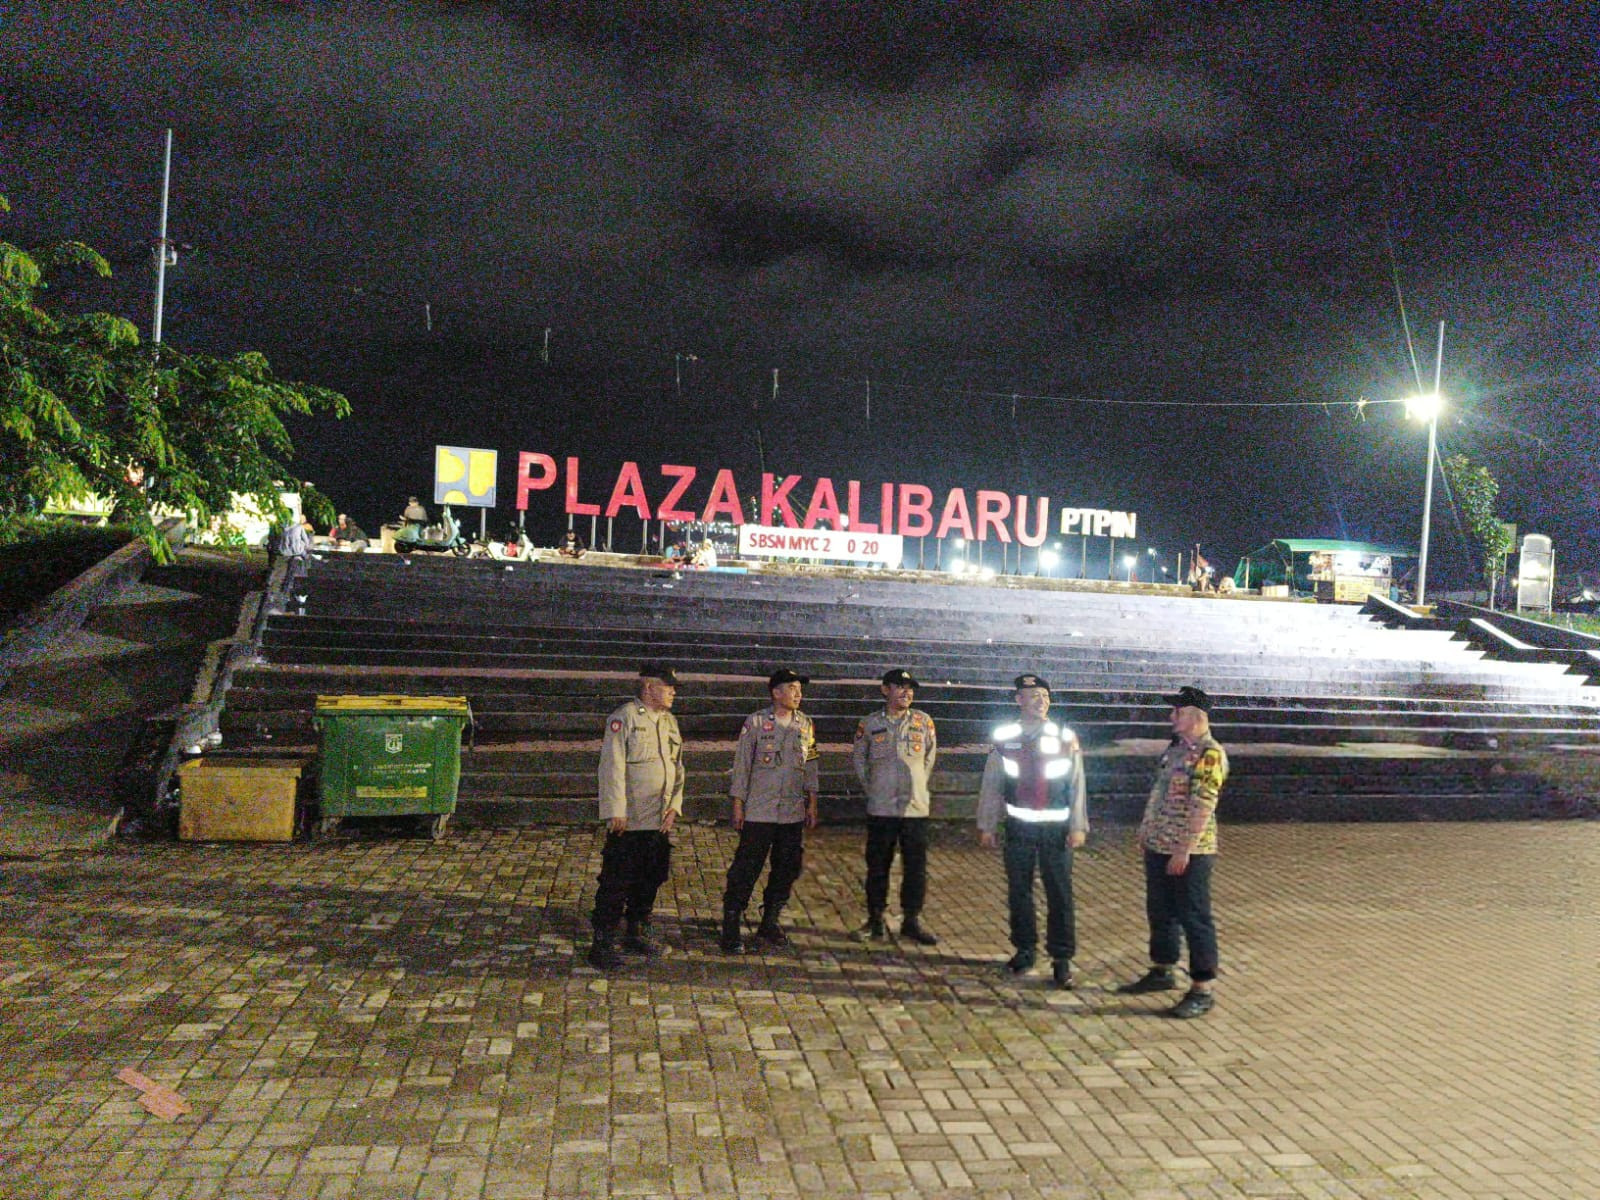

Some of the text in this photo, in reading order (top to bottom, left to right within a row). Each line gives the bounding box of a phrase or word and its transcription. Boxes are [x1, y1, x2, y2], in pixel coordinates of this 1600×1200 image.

[516, 451, 1050, 549] PLAZA KALIBARU
[749, 532, 786, 550] SBSN
[788, 537, 820, 552] MYC
